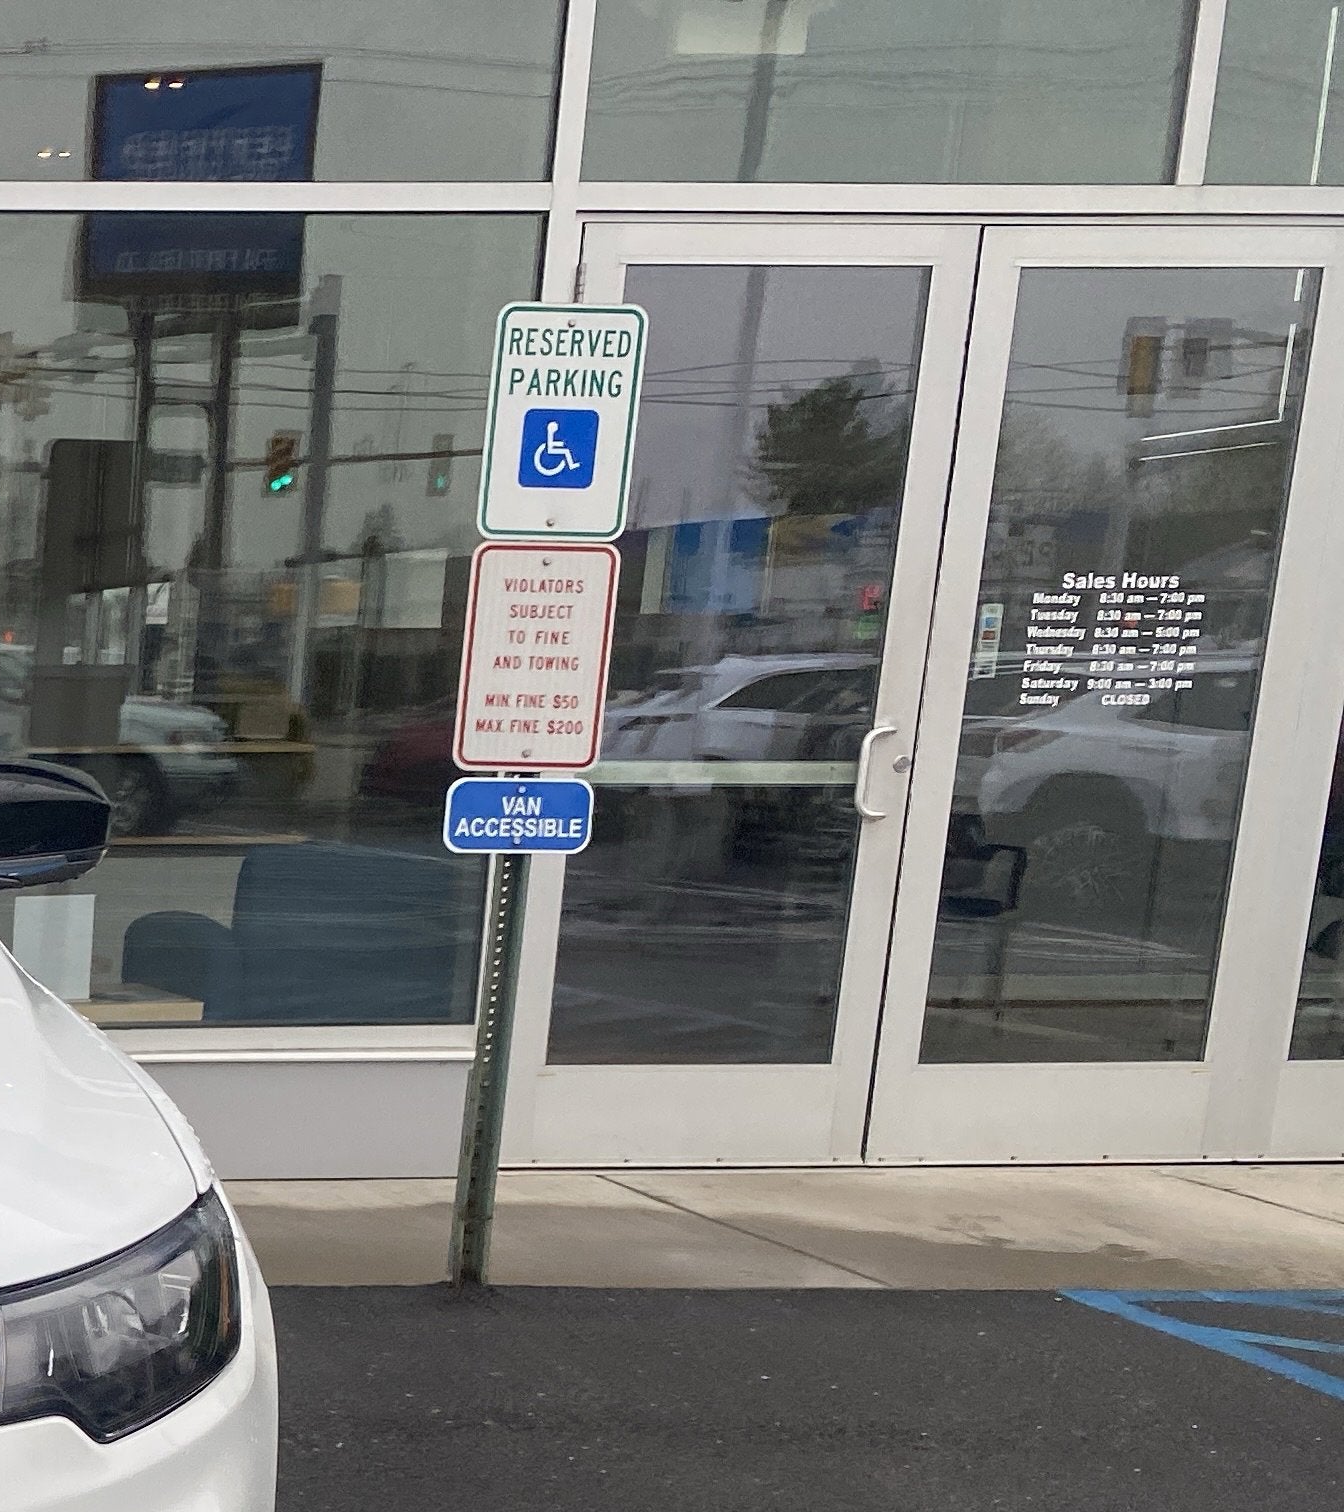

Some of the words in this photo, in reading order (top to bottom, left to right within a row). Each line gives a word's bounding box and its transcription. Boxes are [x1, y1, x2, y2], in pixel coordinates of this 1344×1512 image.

[509, 328, 631, 357] RESERVED
[509, 368, 623, 397] PARKING
[505, 579, 584, 593] VIOLATORS
[1062, 572, 1116, 590] Sales
[1122, 572, 1180, 590] Hours
[1032, 592, 1081, 607] Monday
[1099, 592, 1124, 604] 8:30
[1126, 594, 1145, 604] am
[1160, 592, 1185, 604] 7:00
[1186, 594, 1205, 605] pm
[510, 604, 574, 619] SUBJECT
[1031, 608, 1079, 623] Tuesday
[1096, 610, 1121, 621] 8:30
[1124, 612, 1142, 621] am
[1157, 609, 1183, 621] 7:00
[1184, 611, 1202, 622] pm
[508, 630, 526, 644] TO
[535, 631, 570, 645] FINE
[1027, 626, 1086, 640] Wednesday
[1094, 627, 1119, 638] 8:30
[1121, 629, 1139, 638] am
[1182, 628, 1200, 640] pm
[1026, 643, 1075, 657] Thursday
[1091, 643, 1116, 655] 8:30
[1119, 646, 1136, 655] am
[1152, 643, 1177, 654] 7:00
[1179, 645, 1197, 656] pm
[493, 656, 521, 669] AND
[529, 656, 579, 671] TOWING
[1023, 660, 1063, 674] Friday
[1117, 663, 1134, 671] am
[1150, 661, 1175, 672] 7:00
[1176, 662, 1196, 673] pm
[1021, 677, 1079, 691] Saturday
[1087, 679, 1112, 690] 9:00
[1115, 681, 1132, 689] am
[1148, 678, 1173, 689] 3:00
[1174, 680, 1193, 691] pm
[516, 694, 546, 708] FINE
[552, 694, 579, 709] $50
[1019, 693, 1060, 707] Sunday
[1102, 694, 1150, 705] CLOSED
[510, 719, 539, 733] FINE
[547, 720, 584, 735] $200
[502, 796, 542, 816] VAN
[454, 817, 583, 838] ACCESSIBLE
